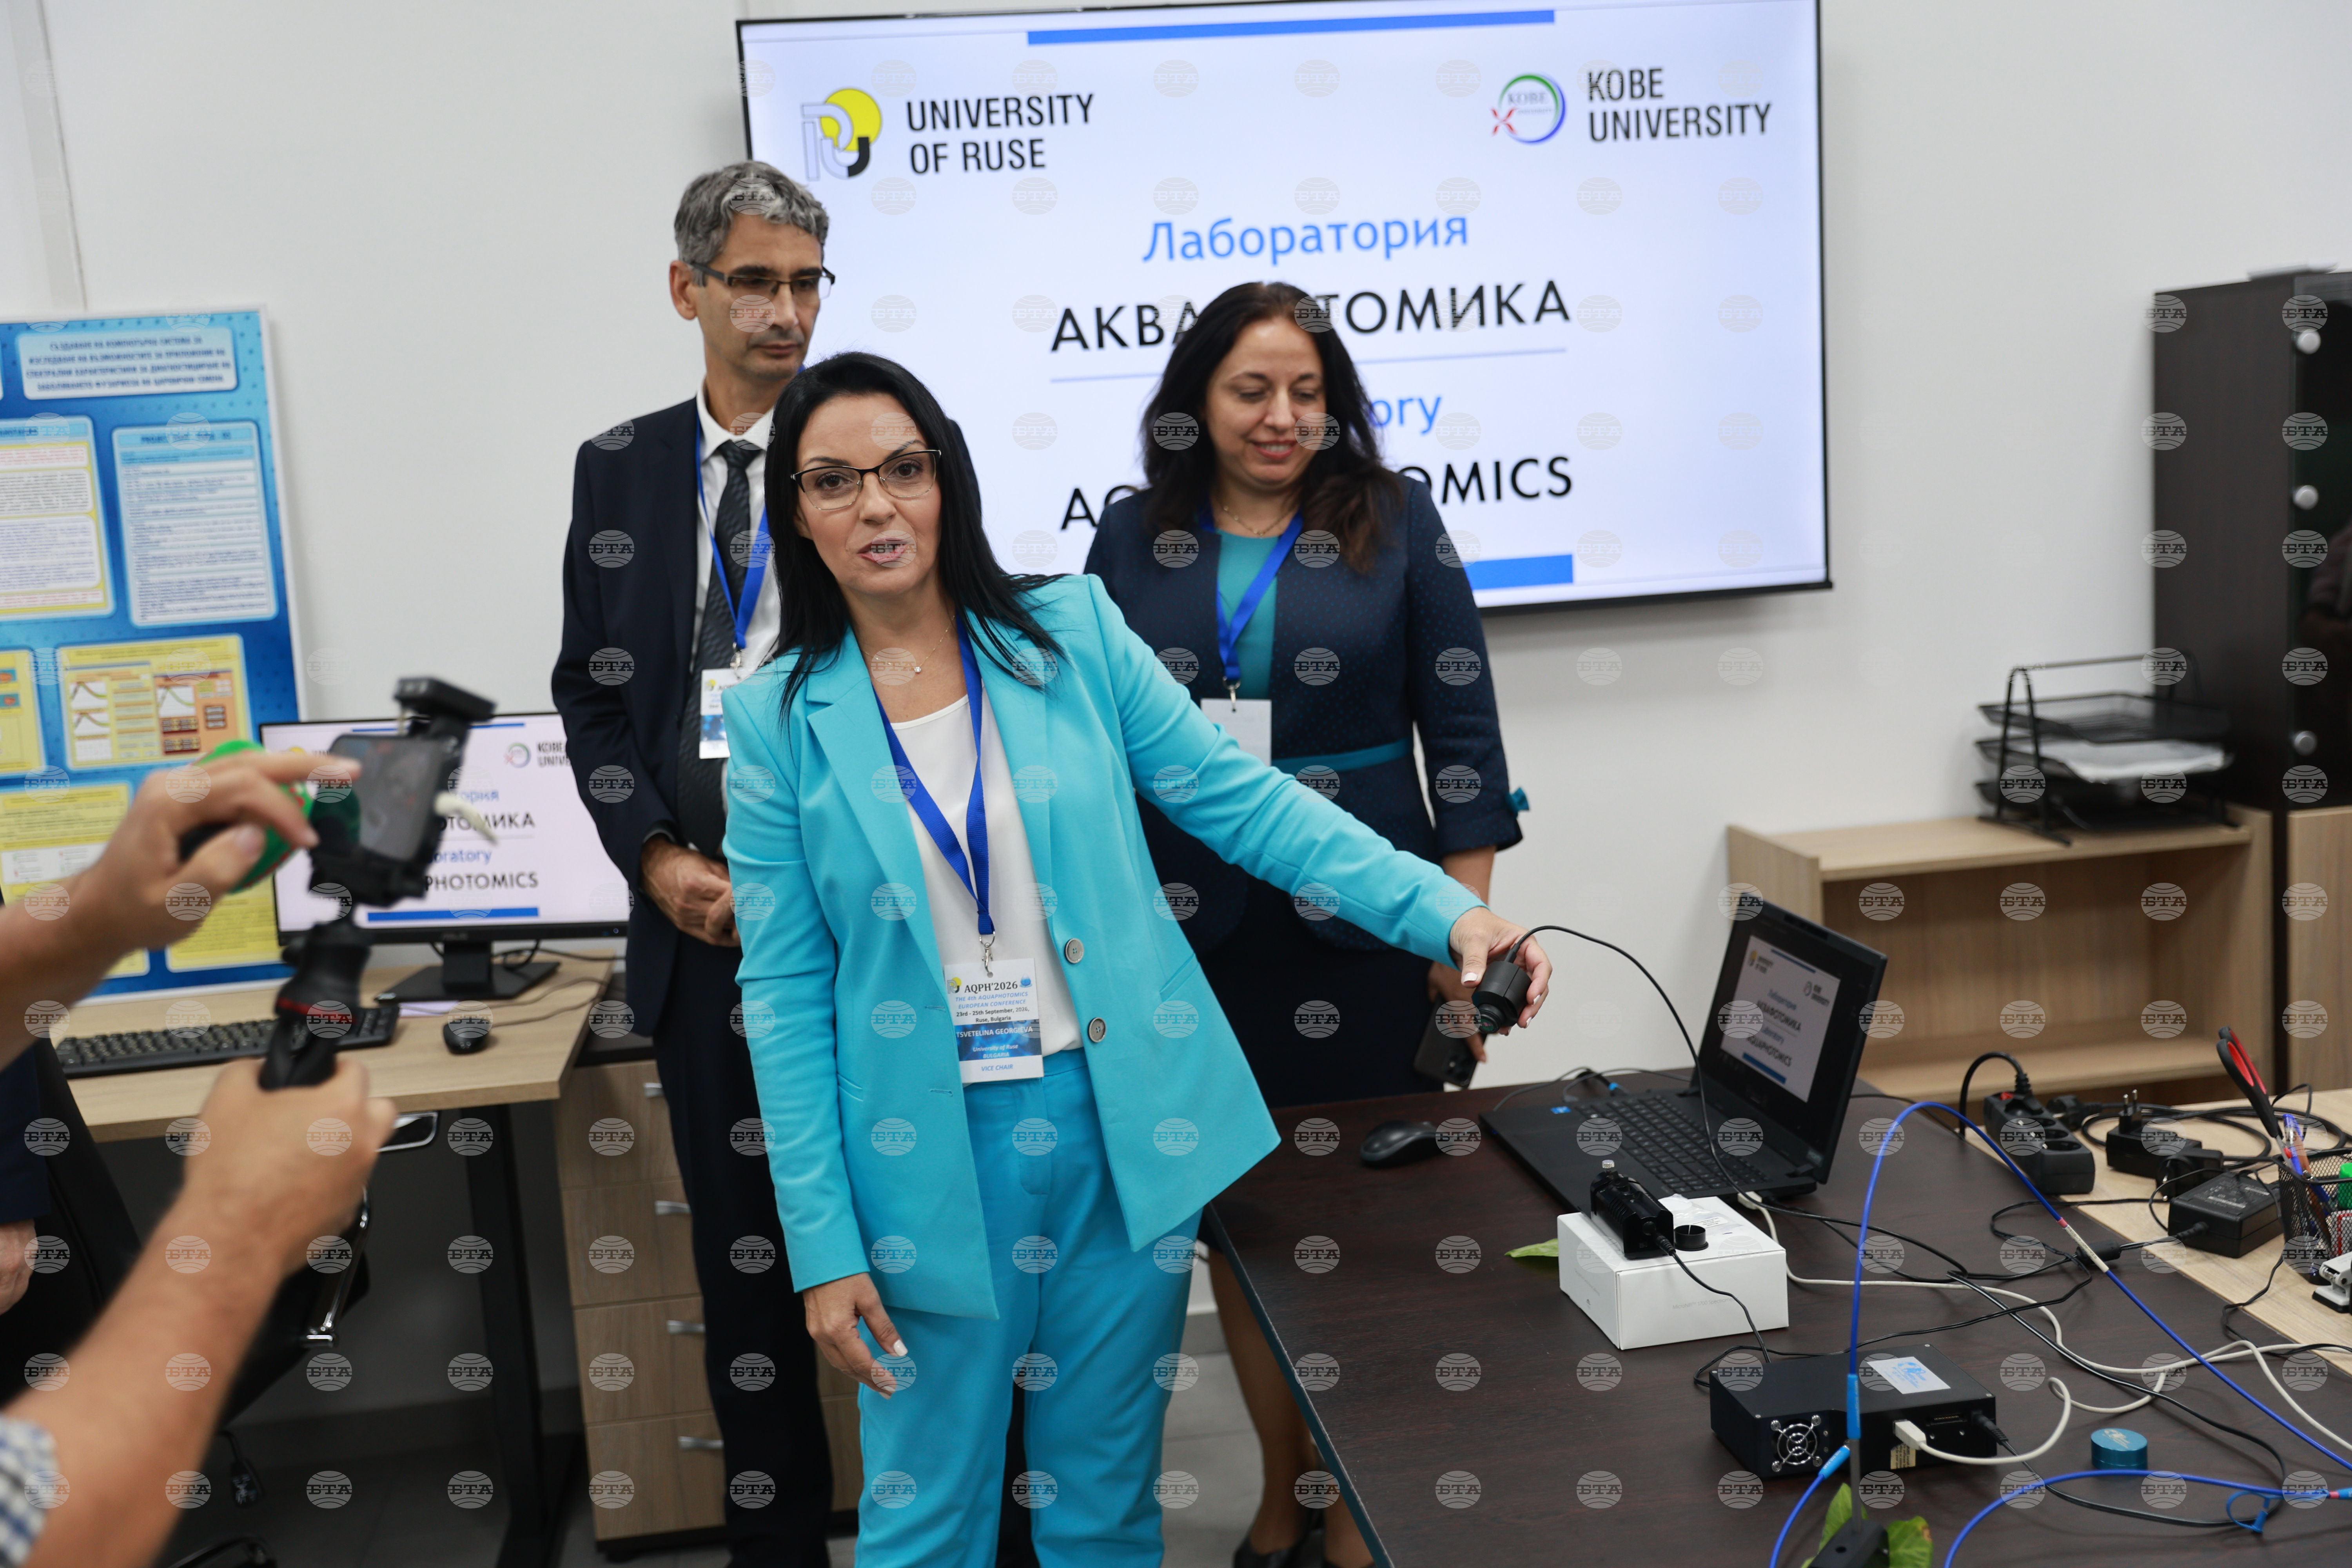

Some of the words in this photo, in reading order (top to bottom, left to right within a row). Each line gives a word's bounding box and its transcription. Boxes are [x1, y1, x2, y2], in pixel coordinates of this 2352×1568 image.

[1588, 68, 1663, 101] KOBE
[906, 94, 1093, 131] UNIVERSITY
[1589, 103, 1771, 142] UNIVERSITY
[910, 143, 948, 174] OF
[962, 139, 1045, 171] RUSE
[1142, 216, 1468, 267] Лаборатория
[538, 742, 563, 753] KOBE
[978, 992, 1028, 1000] AQUAPHOTOMICS
[956, 1029, 994, 1038] TSVETELINA
[995, 1026, 1033, 1035] GEORGIEVA
